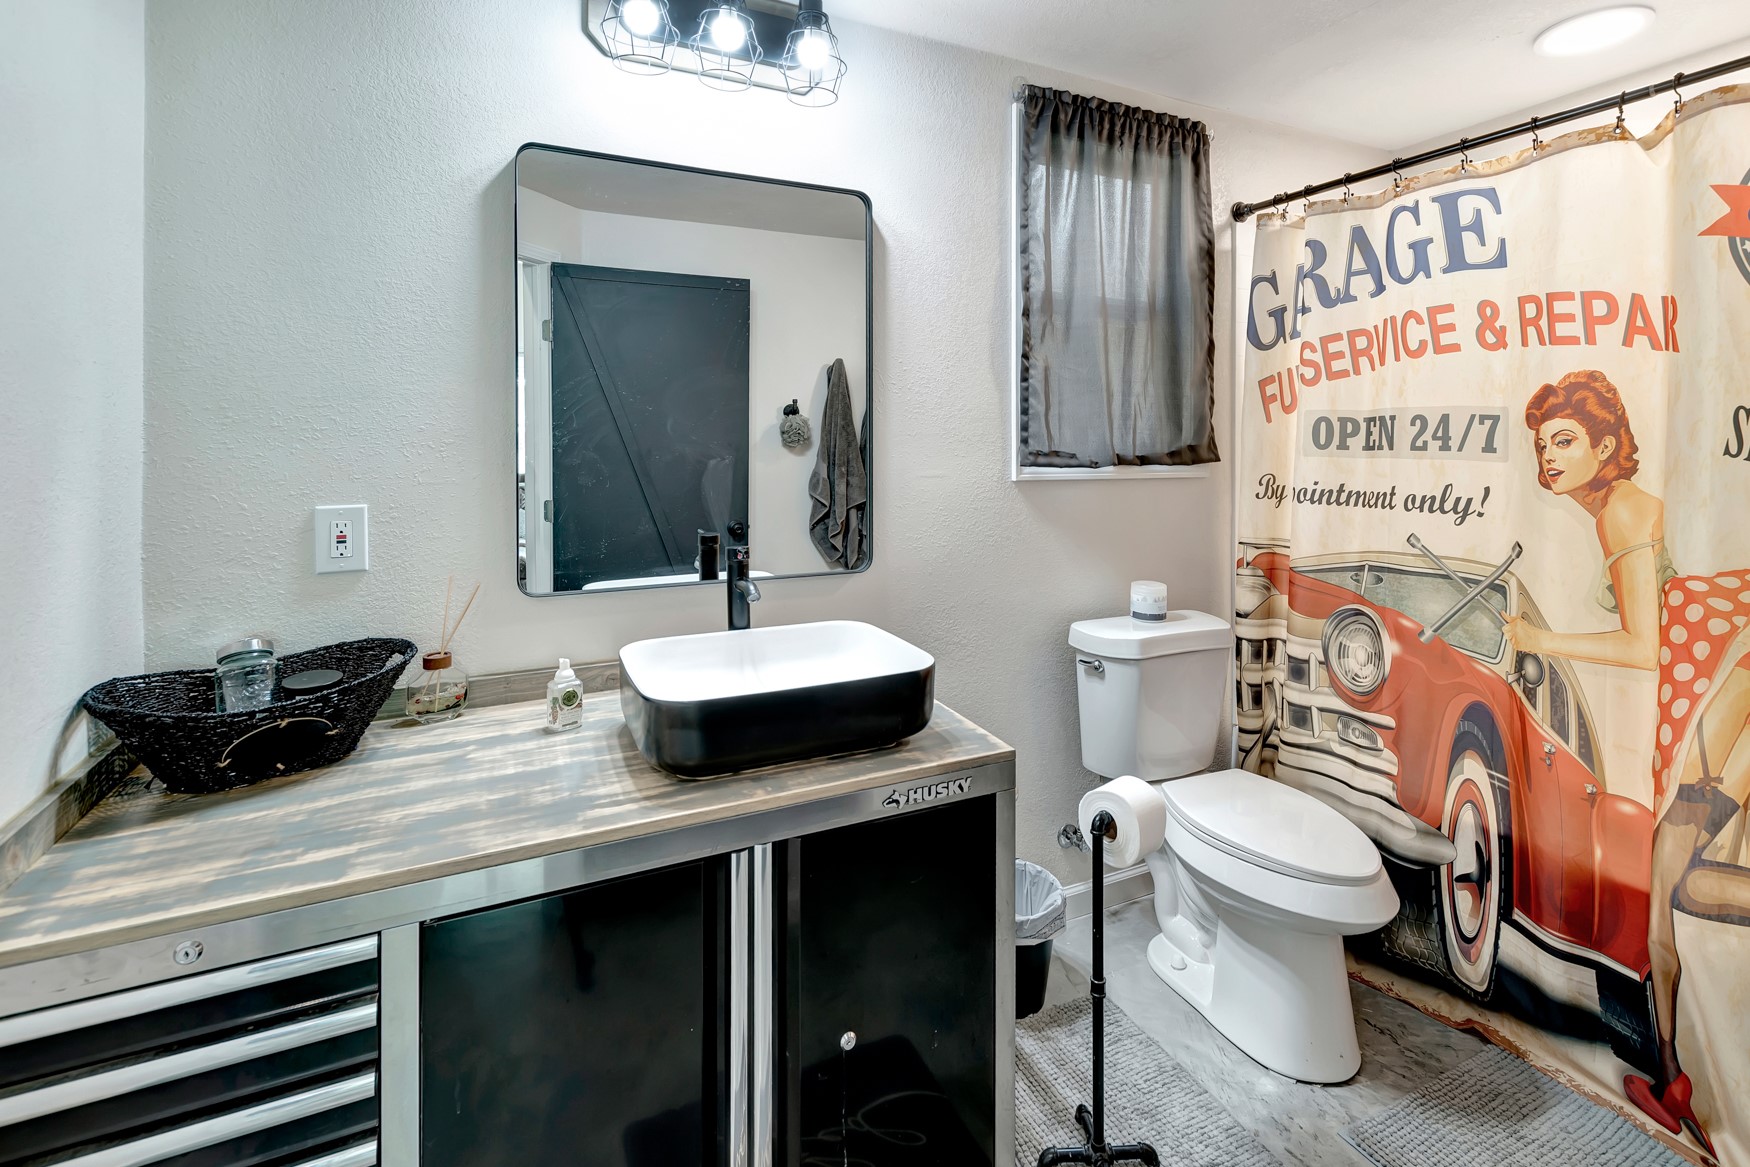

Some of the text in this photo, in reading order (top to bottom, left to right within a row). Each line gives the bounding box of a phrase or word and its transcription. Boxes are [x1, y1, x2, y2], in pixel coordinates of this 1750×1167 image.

[1257, 365, 1299, 424] FU
[1299, 303, 1462, 388] SERVICE
[1475, 299, 1509, 352] &
[1311, 413, 1501, 454] OPEN 24/7
[1255, 473, 1491, 527] By ointment only!
[907, 776, 972, 805] HUSKY
